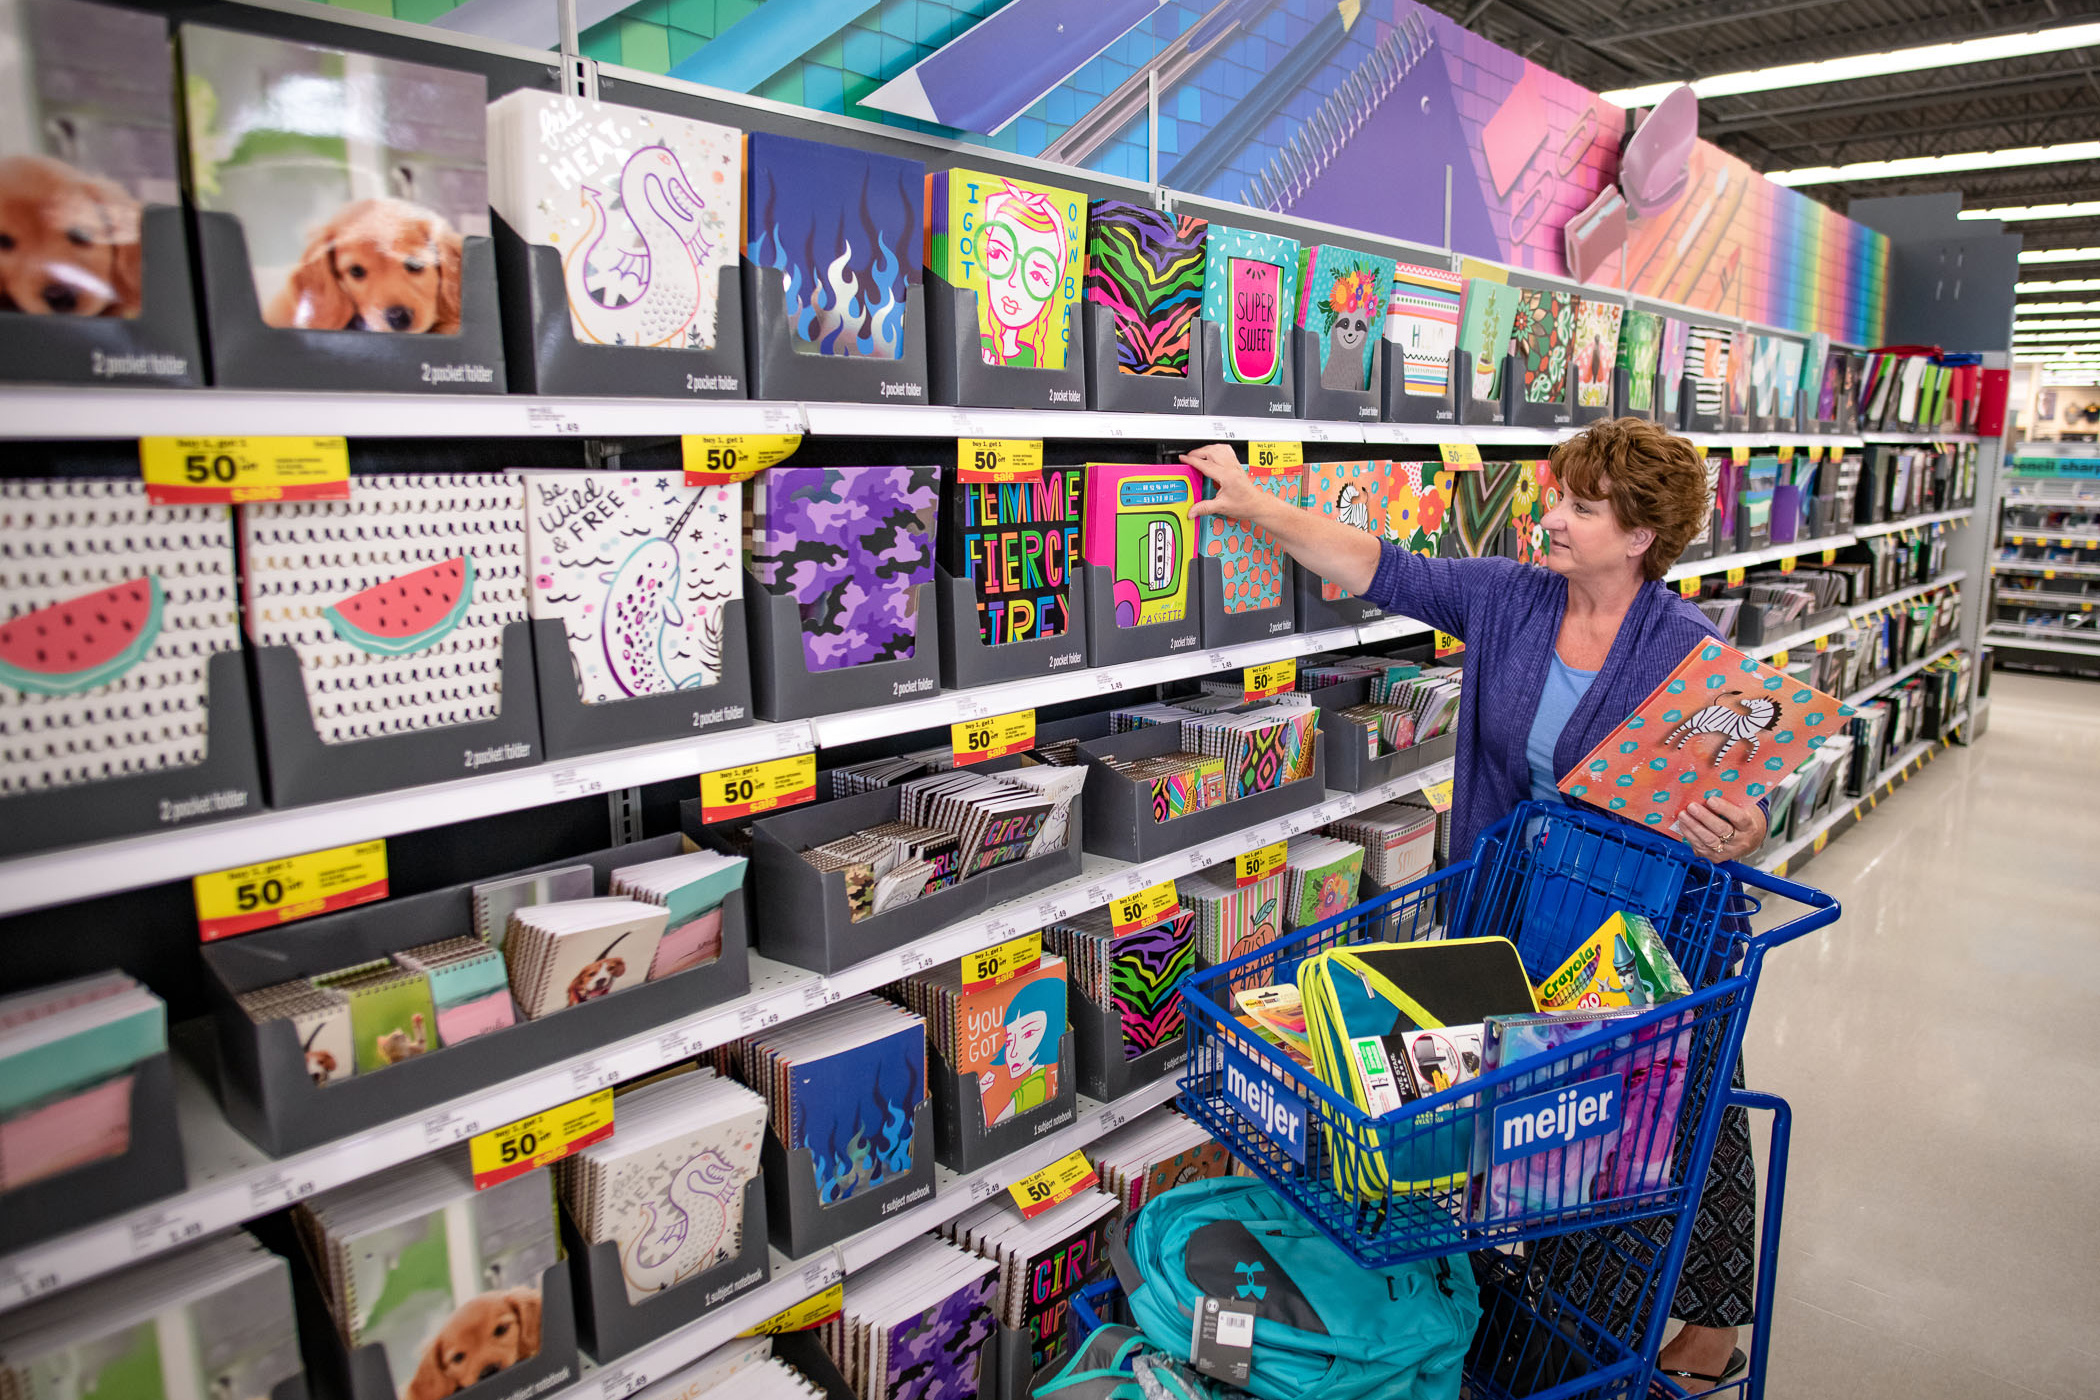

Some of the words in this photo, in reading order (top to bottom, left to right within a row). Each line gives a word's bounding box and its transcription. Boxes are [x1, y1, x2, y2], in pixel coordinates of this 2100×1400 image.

[549, 117, 623, 190] HEAT
[1068, 202, 1079, 263] OWN
[961, 212, 973, 281] GOT
[1236, 292, 1275, 323] SUPER
[1238, 327, 1273, 352] SWEET
[693, 375, 717, 392] pocket
[718, 376, 738, 391] folder
[880, 382, 885, 395] 2
[886, 384, 904, 398] pocket
[905, 384, 921, 397] folder
[1049, 390, 1053, 401] 2
[1053, 390, 1067, 403] pocket
[1067, 391, 1080, 402] folder
[1178, 397, 1189, 408] pocket
[1189, 398, 1199, 408] folder
[1272, 401, 1281, 412] pocket
[1282, 402, 1292, 411] folder
[707, 449, 736, 470] 50
[974, 451, 997, 470] 50
[1259, 451, 1273, 466] 50
[185, 454, 237, 484] 50
[993, 472, 1015, 482] sale
[538, 483, 568, 506] be
[965, 471, 1080, 527] FEMME
[568, 490, 624, 541] FREE
[964, 526, 1078, 594] FIERCE
[1141, 608, 1182, 625] CASSETTE
[1273, 622, 1282, 634] pocket
[1283, 620, 1291, 630] folder
[1174, 638, 1186, 650] pocket
[1186, 635, 1196, 646] folder
[1441, 635, 1451, 648] 50
[1049, 655, 1053, 667] 2
[1053, 655, 1068, 669] pocket
[1068, 653, 1081, 666] folder
[1222, 661, 1233, 669] 1.49
[893, 682, 898, 695] 2
[898, 680, 917, 697] pocket
[918, 678, 933, 691] folder
[1110, 682, 1123, 691] 1.49
[1254, 673, 1268, 690] 50
[699, 709, 723, 729] pocket
[724, 706, 745, 722] folder
[965, 723, 974, 731] buy
[982, 720, 990, 728] get
[968, 730, 990, 751] 50
[987, 745, 1007, 759] sale
[725, 779, 753, 804] 50
[749, 796, 778, 813] sale
[1323, 814, 1332, 822] 1.49
[985, 812, 1046, 847] GIRLS
[973, 839, 1031, 871] SUPPORT
[1202, 858, 1213, 867] 1.49
[1246, 858, 1260, 875] 50
[237, 879, 284, 911] 50
[1119, 897, 1128, 905] buy
[1132, 894, 1140, 902] get
[1054, 909, 1067, 920] 1.49
[1123, 902, 1142, 922] 50
[1141, 914, 1158, 928] sale
[1002, 927, 1016, 939] 1.49
[974, 953, 985, 961] buy
[990, 948, 999, 957] get
[917, 957, 932, 970] 1.49
[977, 958, 999, 979] 50
[1543, 945, 1595, 999] Crayola
[994, 970, 1015, 986] sale
[823, 991, 840, 1004] 1.49
[760, 1014, 779, 1027] 1.49
[968, 1004, 1003, 1032] YOU
[683, 1041, 703, 1055] 1.49
[968, 1035, 998, 1062] GOT
[1167, 1056, 1179, 1070] subject
[1227, 1063, 1299, 1144] meijer
[1034, 1126, 1038, 1136] 1
[1038, 1121, 1052, 1136] subject
[1053, 1111, 1072, 1128] notebook
[1113, 1116, 1125, 1127] 2.49
[1502, 1090, 1613, 1151] meijer
[501, 1133, 536, 1164] 50
[617, 1160, 669, 1216] HEAT
[985, 1183, 1000, 1197] 2.49
[1019, 1178, 1030, 1187] buy
[882, 1203, 886, 1214] 1
[887, 1196, 905, 1213] subject
[905, 1184, 930, 1203] notebook
[1026, 1182, 1050, 1202] 50
[1053, 1188, 1072, 1205] sale
[711, 1285, 732, 1304] subject
[732, 1268, 763, 1292] notebook
